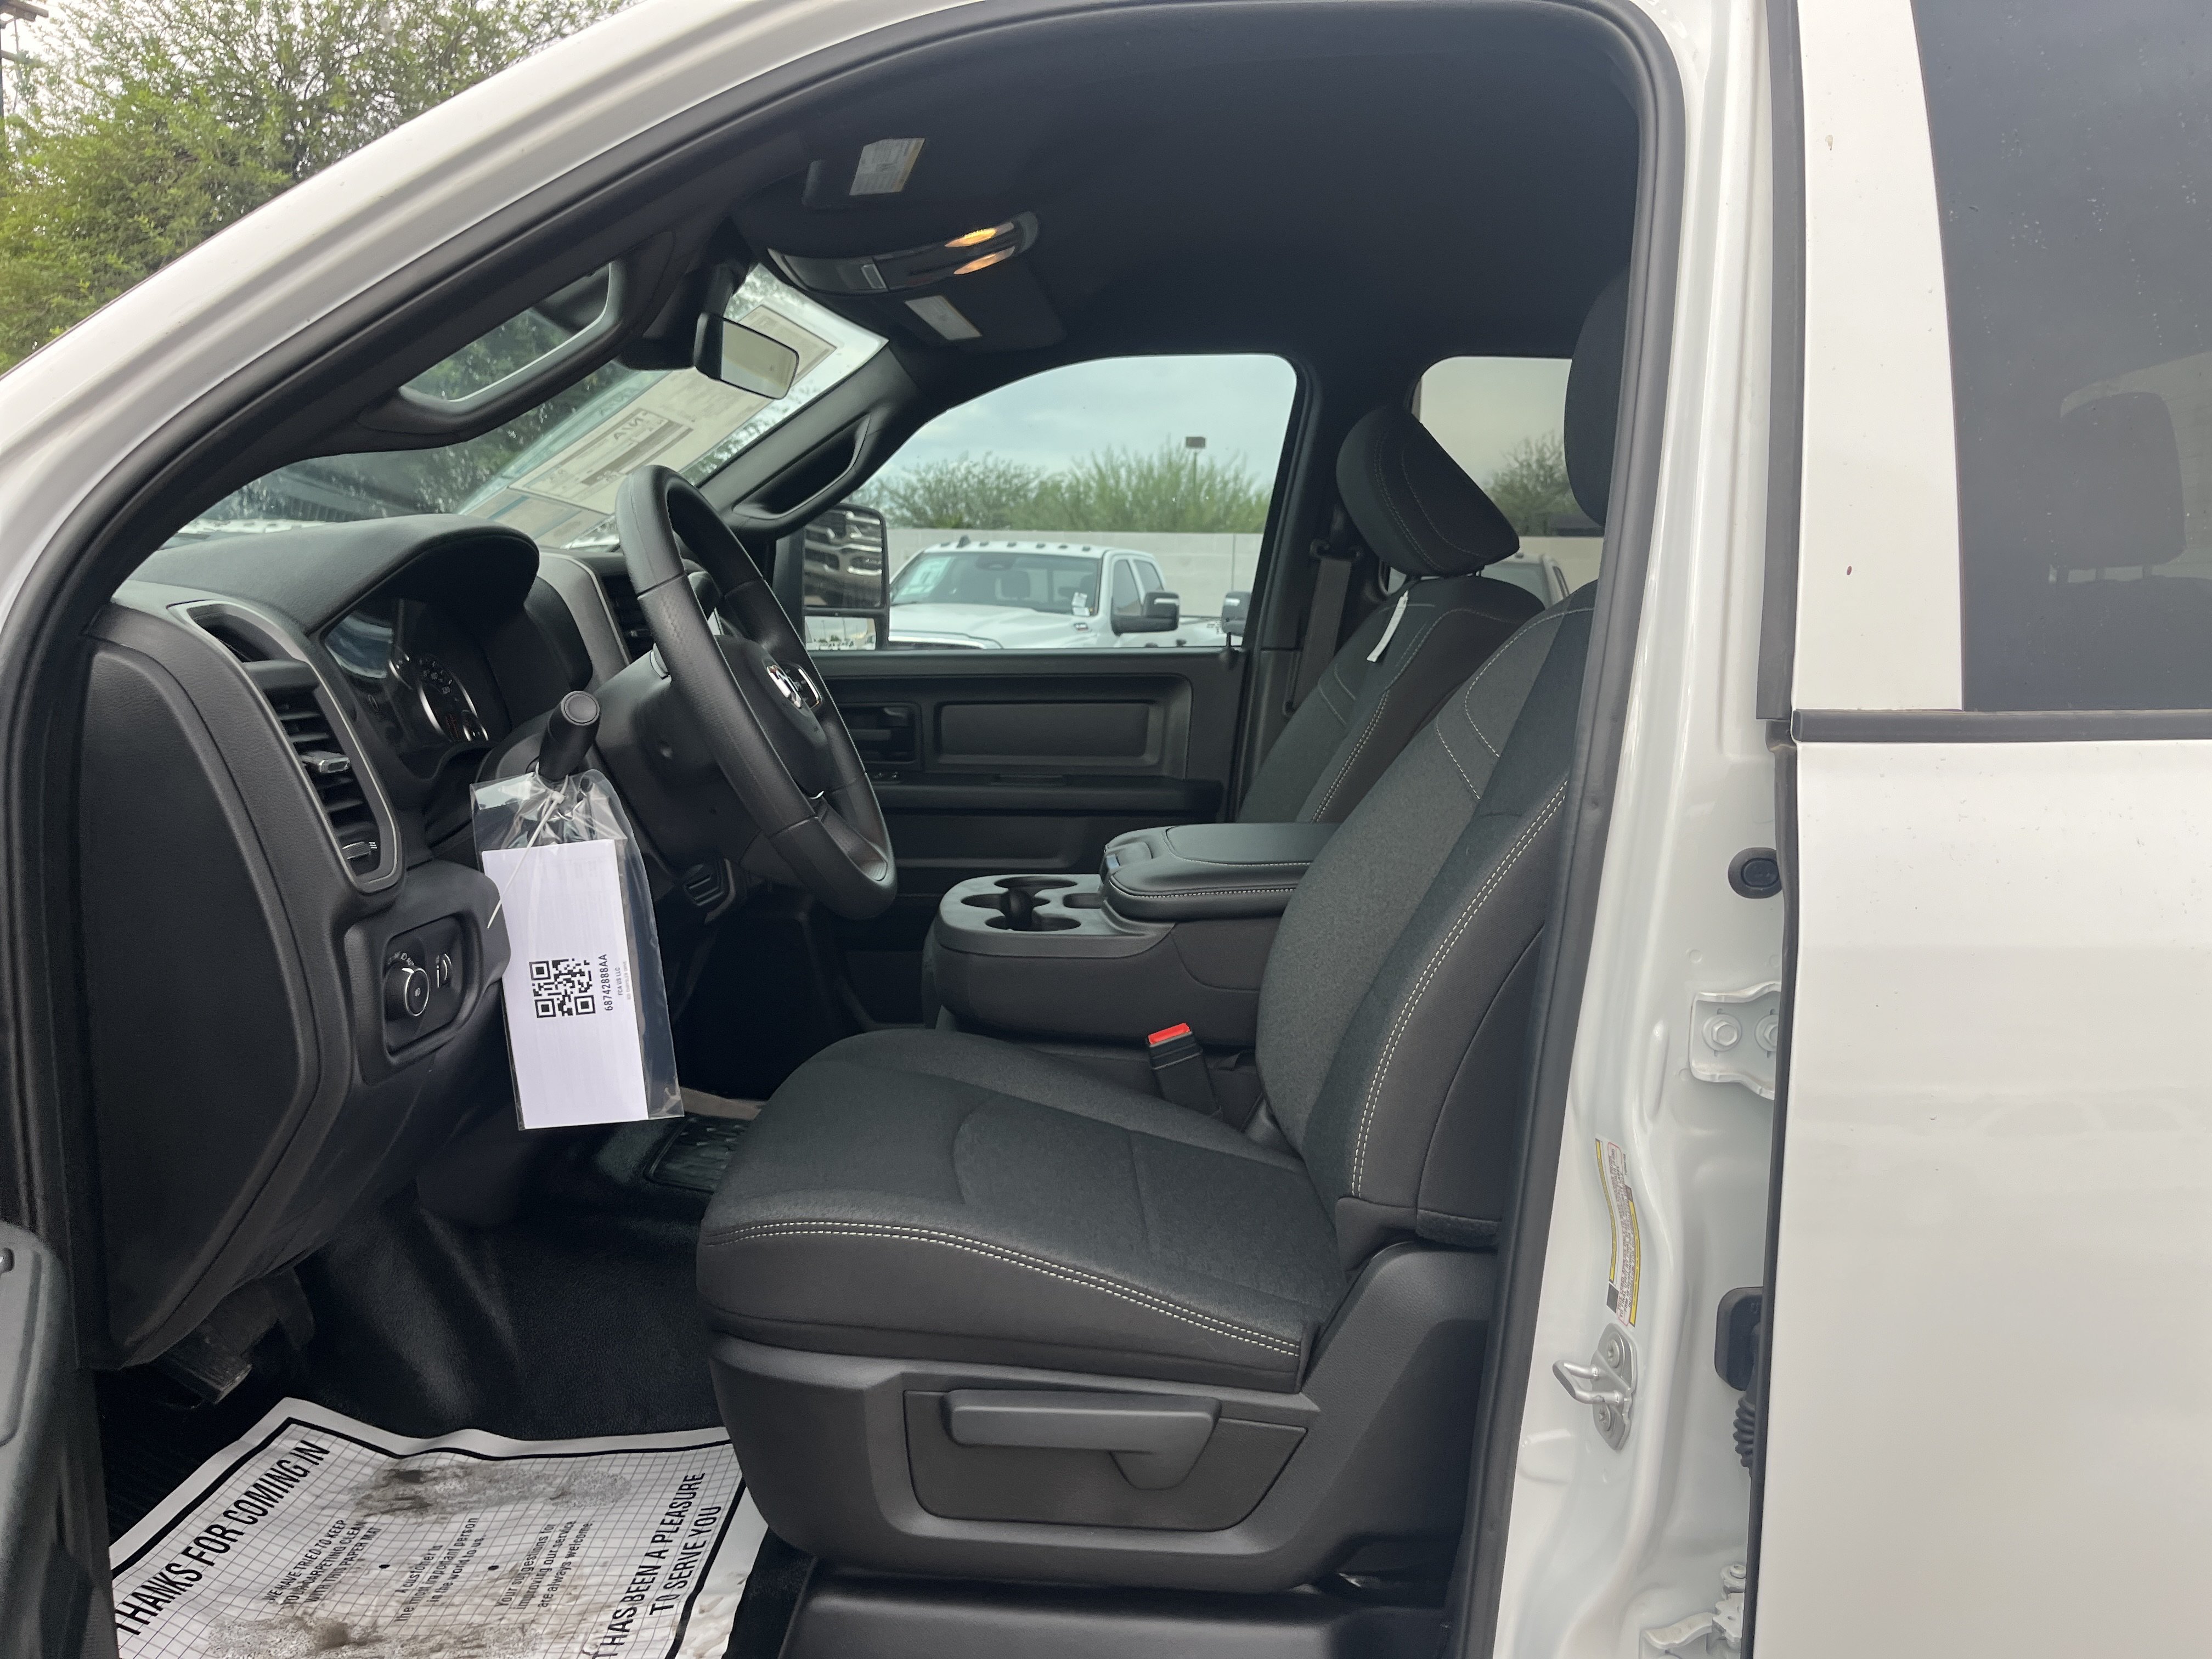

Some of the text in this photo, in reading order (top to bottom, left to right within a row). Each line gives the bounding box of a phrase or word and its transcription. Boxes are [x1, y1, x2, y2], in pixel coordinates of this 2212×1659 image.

[598, 954, 613, 1011] 68742888AA
[182, 1524, 245, 1566] FOR
[223, 1460, 310, 1525] COMING
[290, 1440, 330, 1465] IN
[651, 1472, 706, 1544] PLEASURE
[262, 1520, 347, 1600] WE HAVE TRIED TO KEEP
[280, 1522, 367, 1605] YOUR CARPETING CLEAN
[304, 1527, 382, 1602] WITH THIS PAPER MAT
[403, 1553, 436, 1587] customer
[409, 1587, 432, 1604] most
[422, 1549, 460, 1584] important
[454, 1518, 478, 1546] person
[426, 1534, 487, 1602] in the world to us.
[495, 1524, 556, 1607] Your suggestions for
[513, 1520, 576, 1609] improving our service
[538, 1520, 595, 1607] are always welcome.
[620, 1565, 662, 1603] BEEN
[645, 1549, 669, 1559] A
[649, 1506, 721, 1616] TO SERVE YOU
[600, 1606, 637, 1646] HAS
